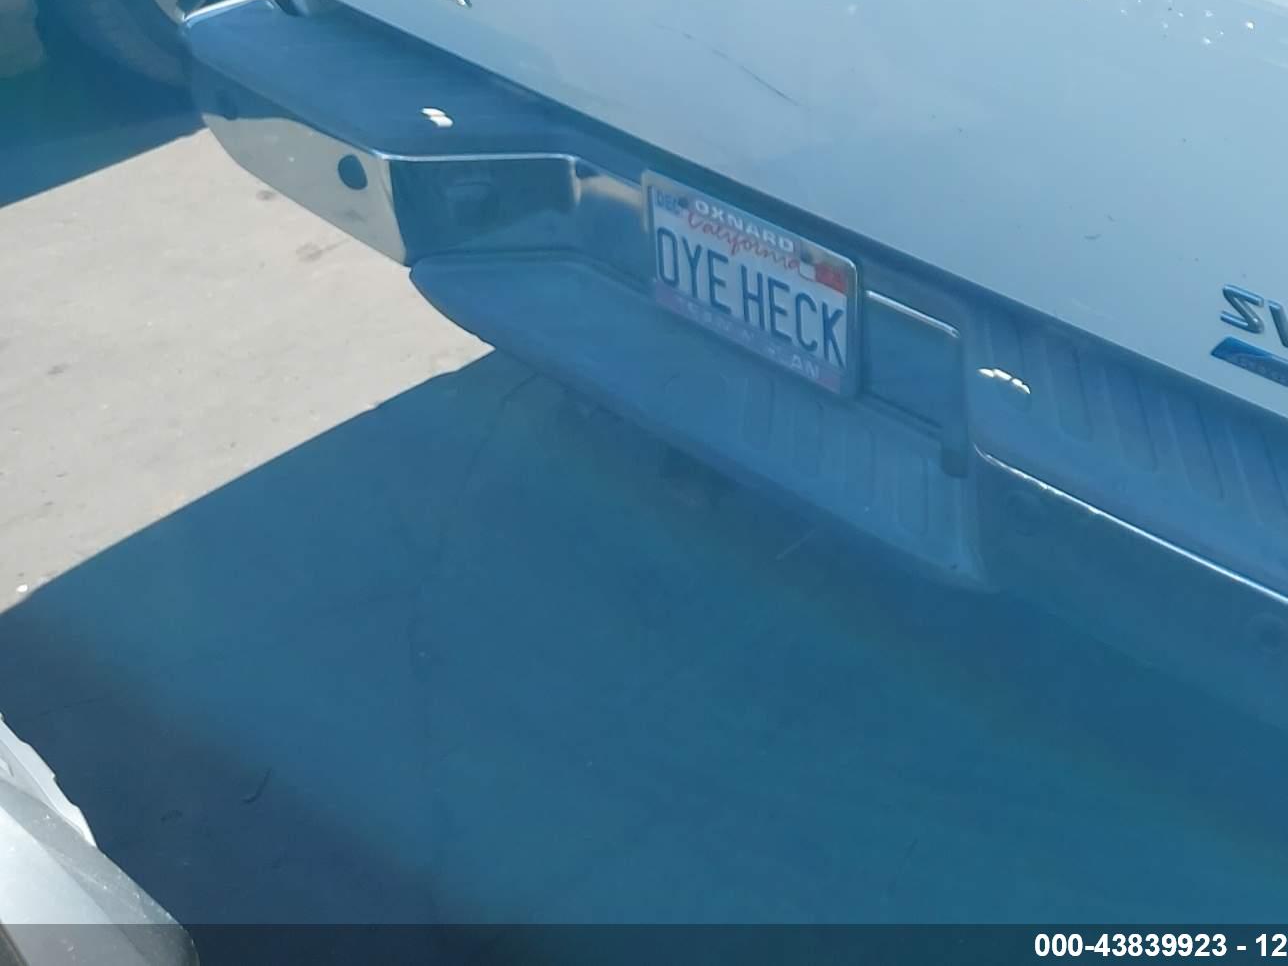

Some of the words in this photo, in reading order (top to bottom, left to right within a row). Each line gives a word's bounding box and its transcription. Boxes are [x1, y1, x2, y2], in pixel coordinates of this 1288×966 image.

[688, 207, 801, 270] California
[695, 200, 794, 253] OXNARD
[740, 263, 846, 369] HECK
